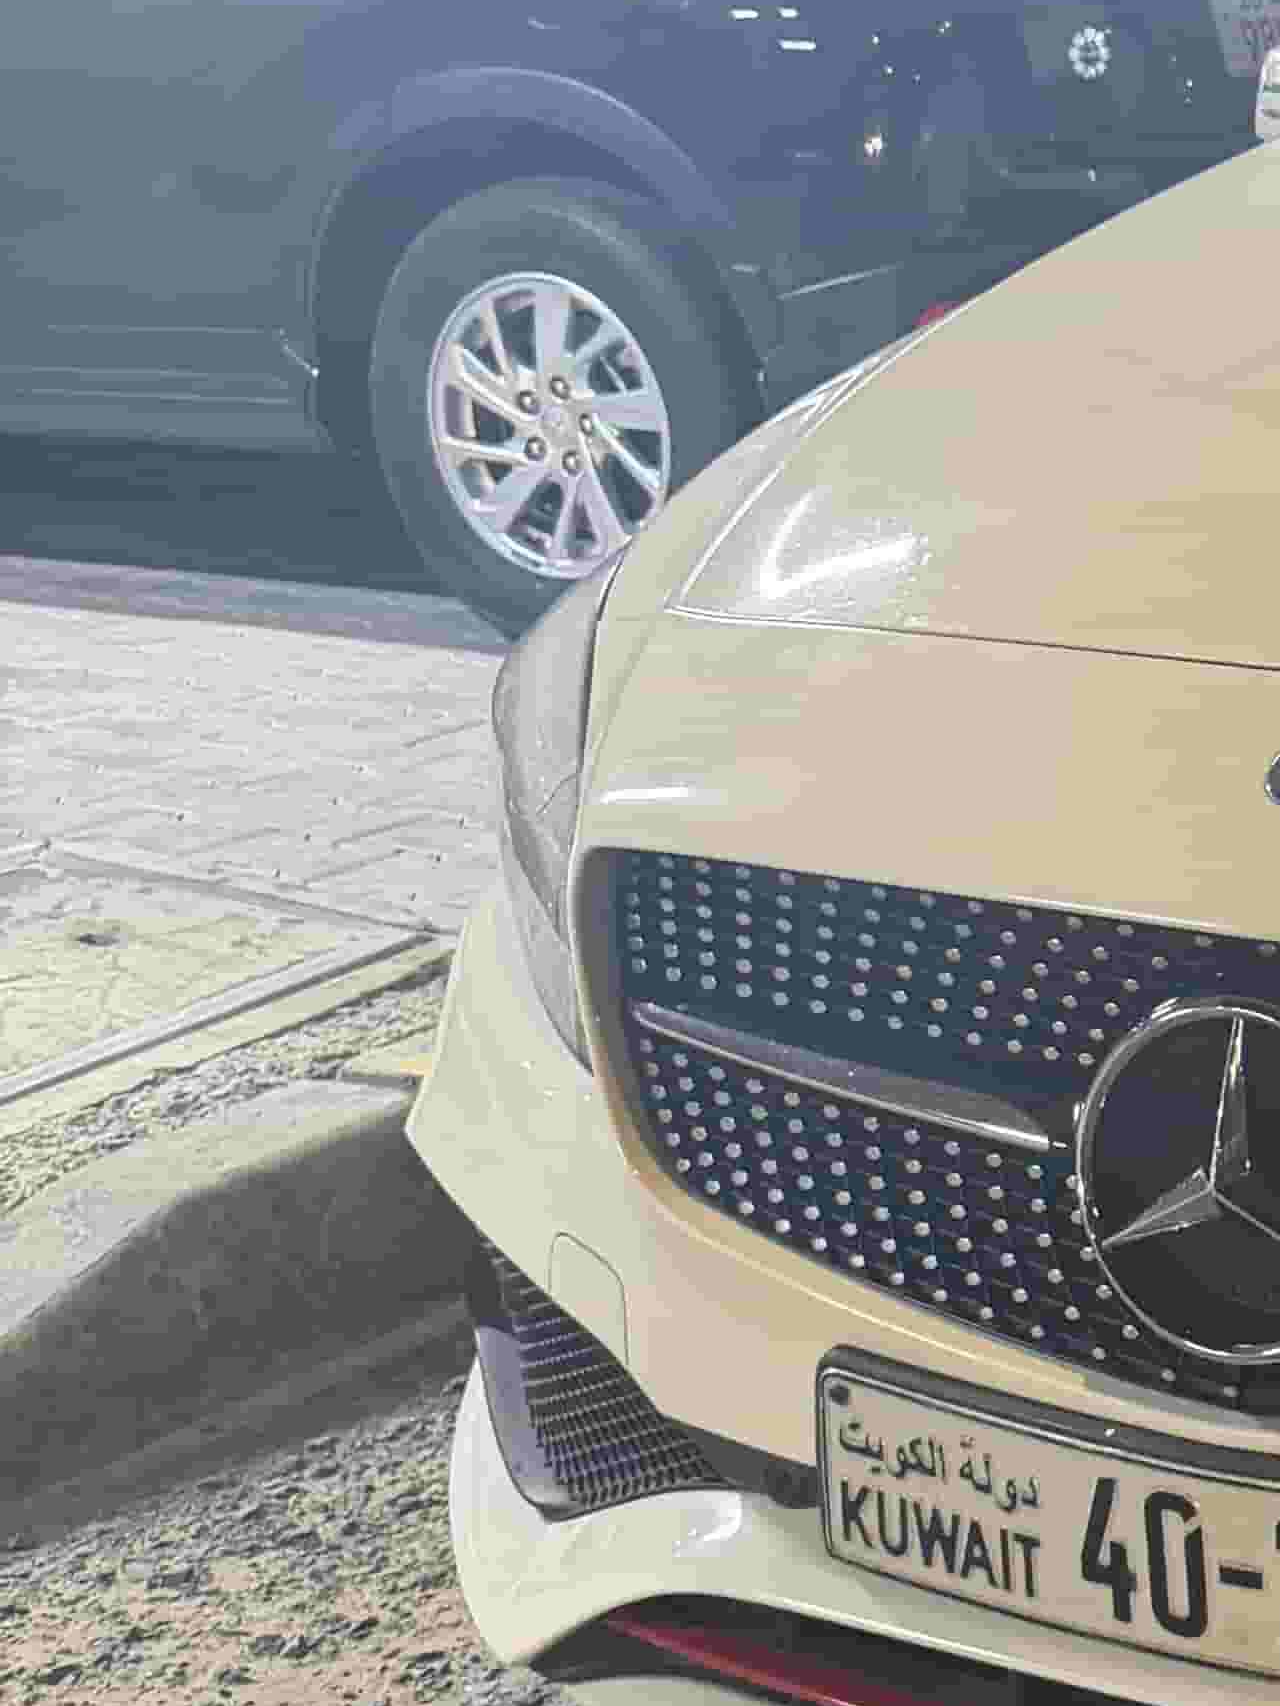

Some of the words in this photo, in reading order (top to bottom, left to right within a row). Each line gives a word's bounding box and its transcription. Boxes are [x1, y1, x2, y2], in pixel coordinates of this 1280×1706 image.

[839, 1421, 948, 1486] الكويت
[959, 1436, 1041, 1513] دولة
[841, 1477, 1041, 1598] KUWAIT
